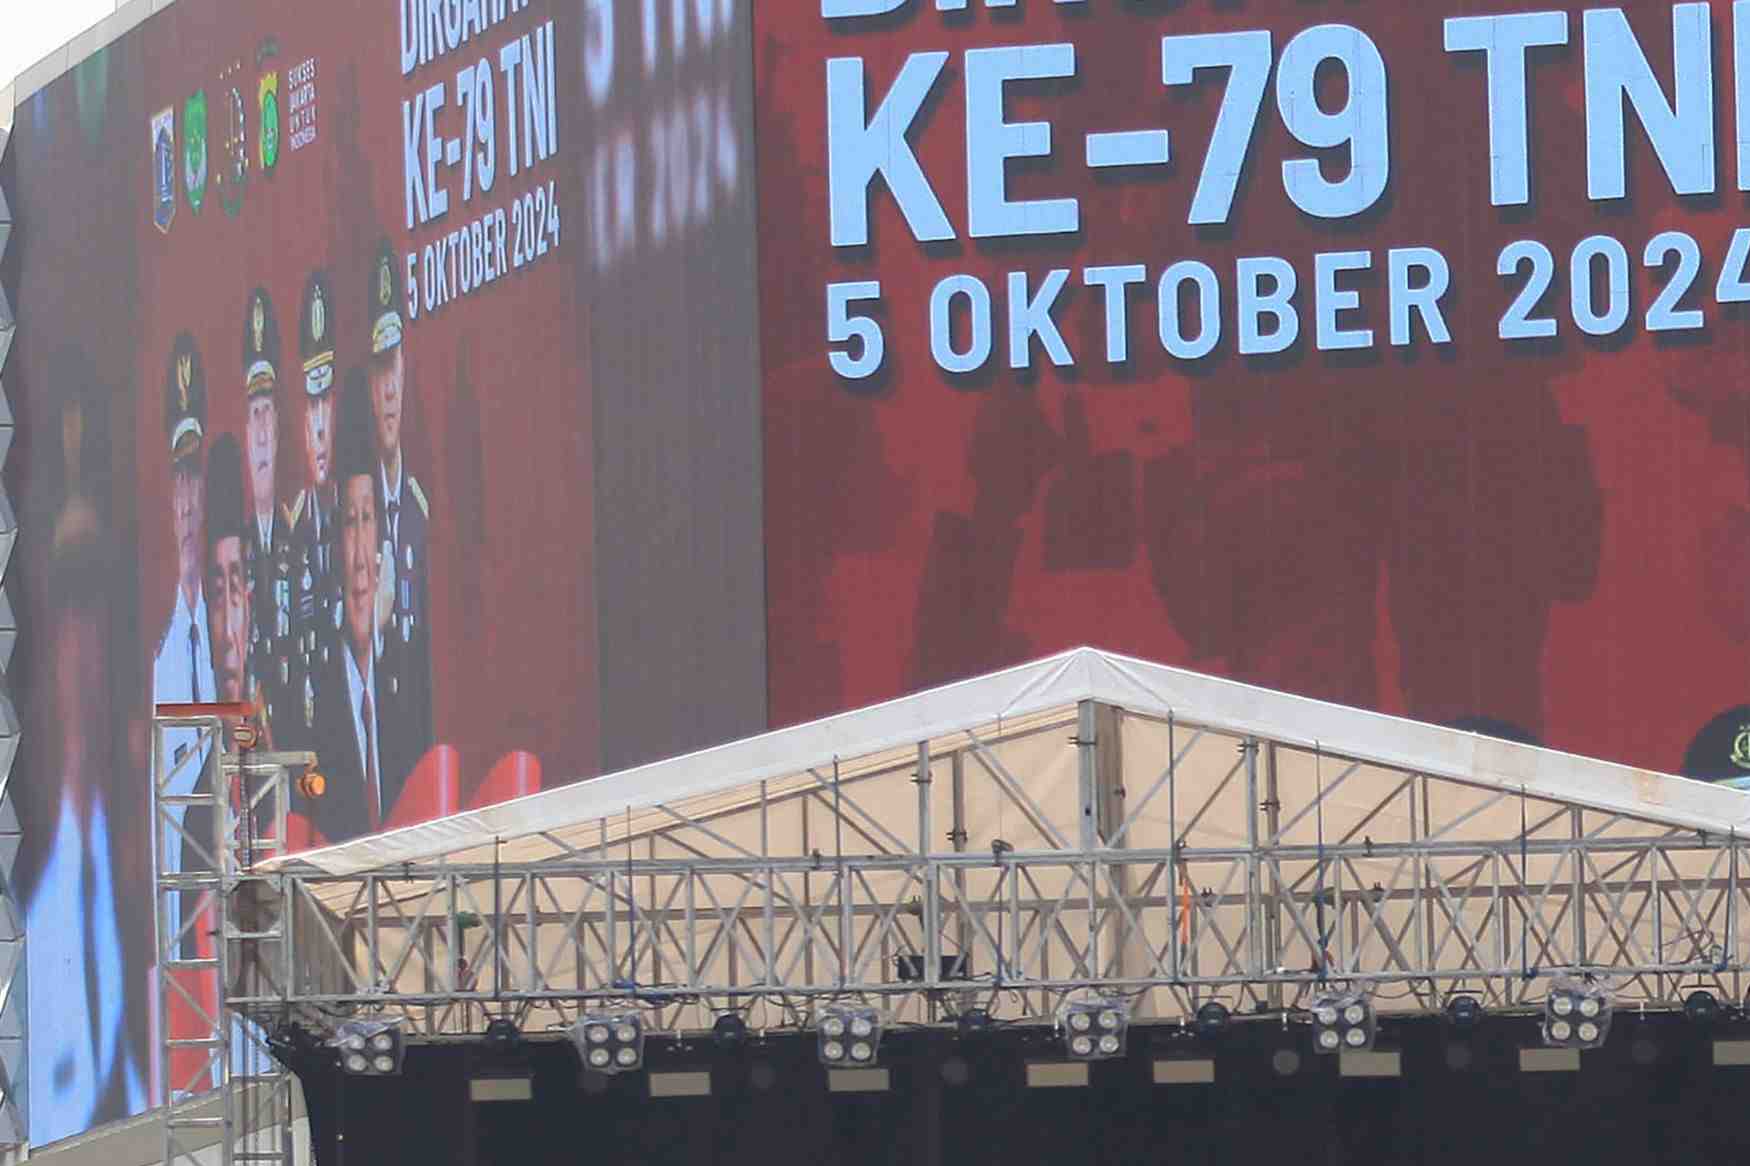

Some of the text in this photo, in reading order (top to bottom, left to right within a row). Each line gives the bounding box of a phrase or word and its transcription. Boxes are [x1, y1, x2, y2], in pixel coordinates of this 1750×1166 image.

[403, 57, 497, 230] KE-79
[500, 19, 559, 177] TNI
[826, 24, 1389, 246] KE-79
[406, 252, 419, 321] 5
[423, 207, 508, 313] OKTOBER
[512, 179, 561, 271] 2024
[826, 280, 884, 379] 5
[929, 247, 1452, 373] OKTOBER
